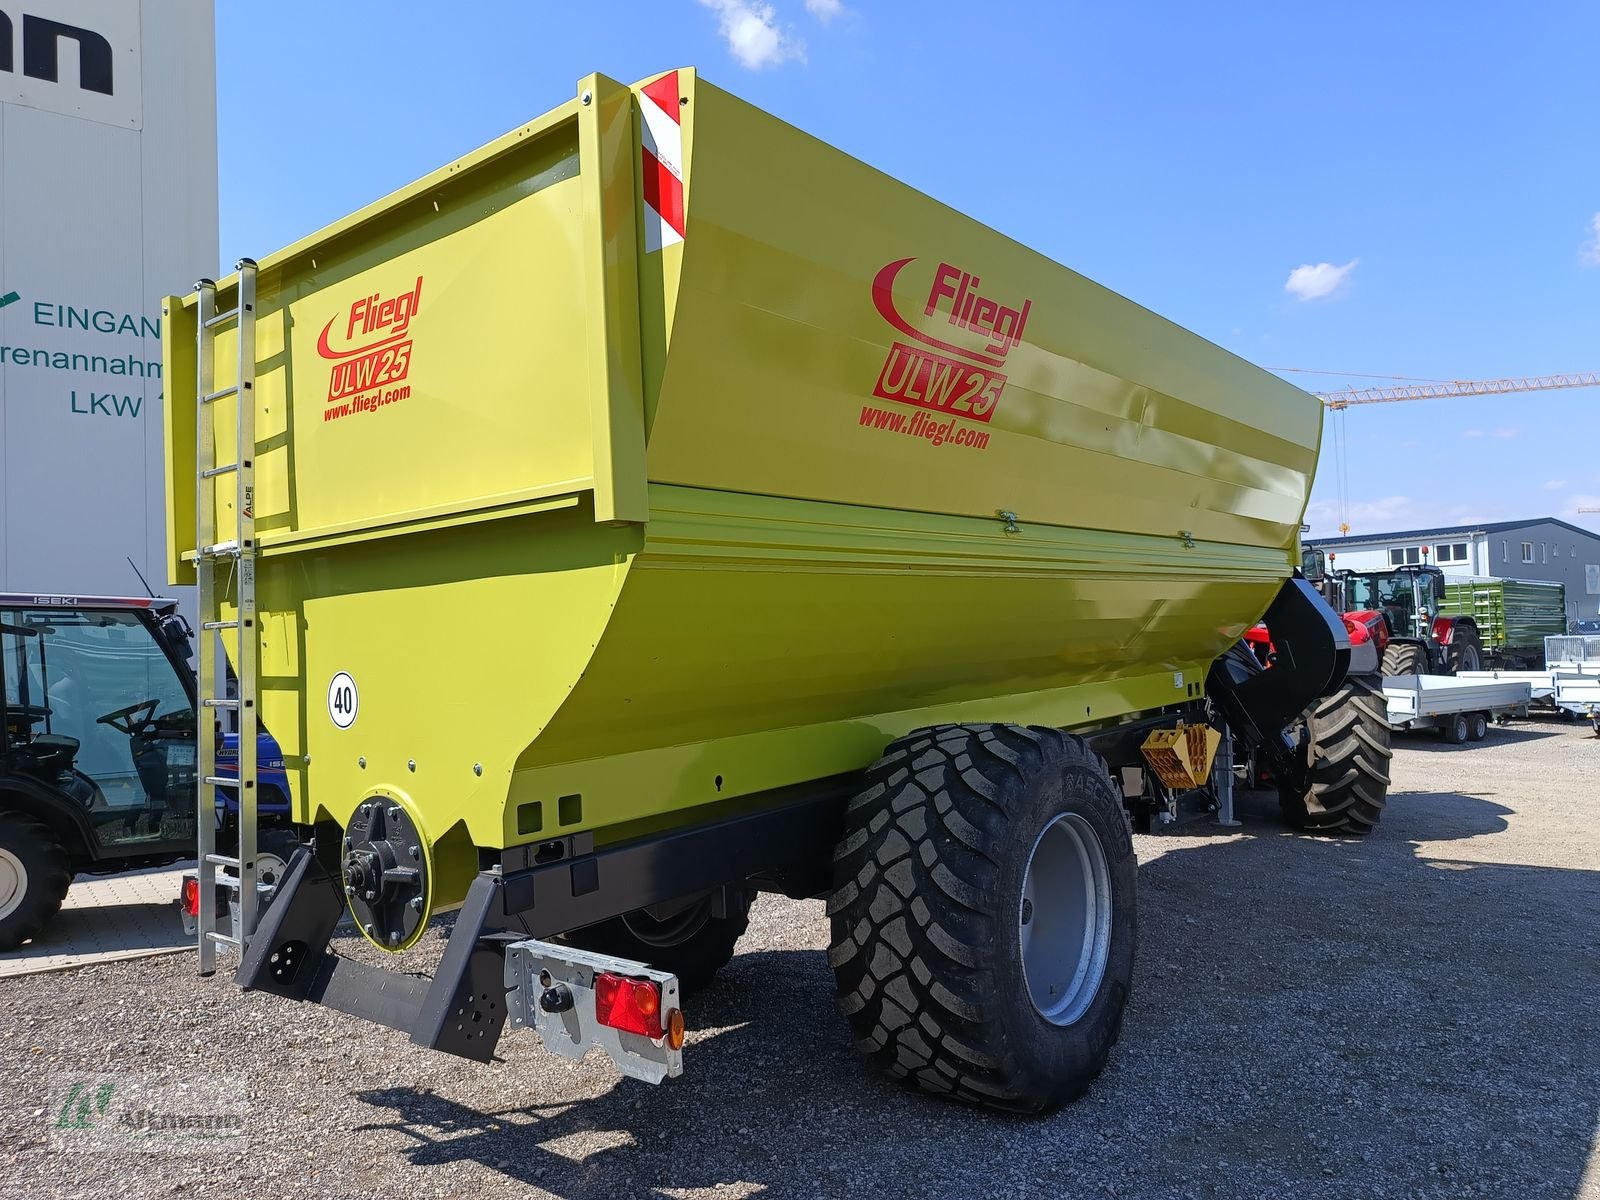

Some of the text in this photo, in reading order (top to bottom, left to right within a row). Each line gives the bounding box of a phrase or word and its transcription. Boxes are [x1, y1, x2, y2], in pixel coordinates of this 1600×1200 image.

[0, 9, 113, 96] n
[34, 302, 161, 339] EINGAN
[347, 276, 423, 340] Fliegl
[924, 262, 1032, 357] Fliegl
[71, 391, 142, 418] LKW
[324, 385, 411, 422] www.fliegl.com
[859, 406, 990, 449] www.fliegl.com
[33, 597, 78, 605] ISEKI
[334, 686, 352, 714] 40
